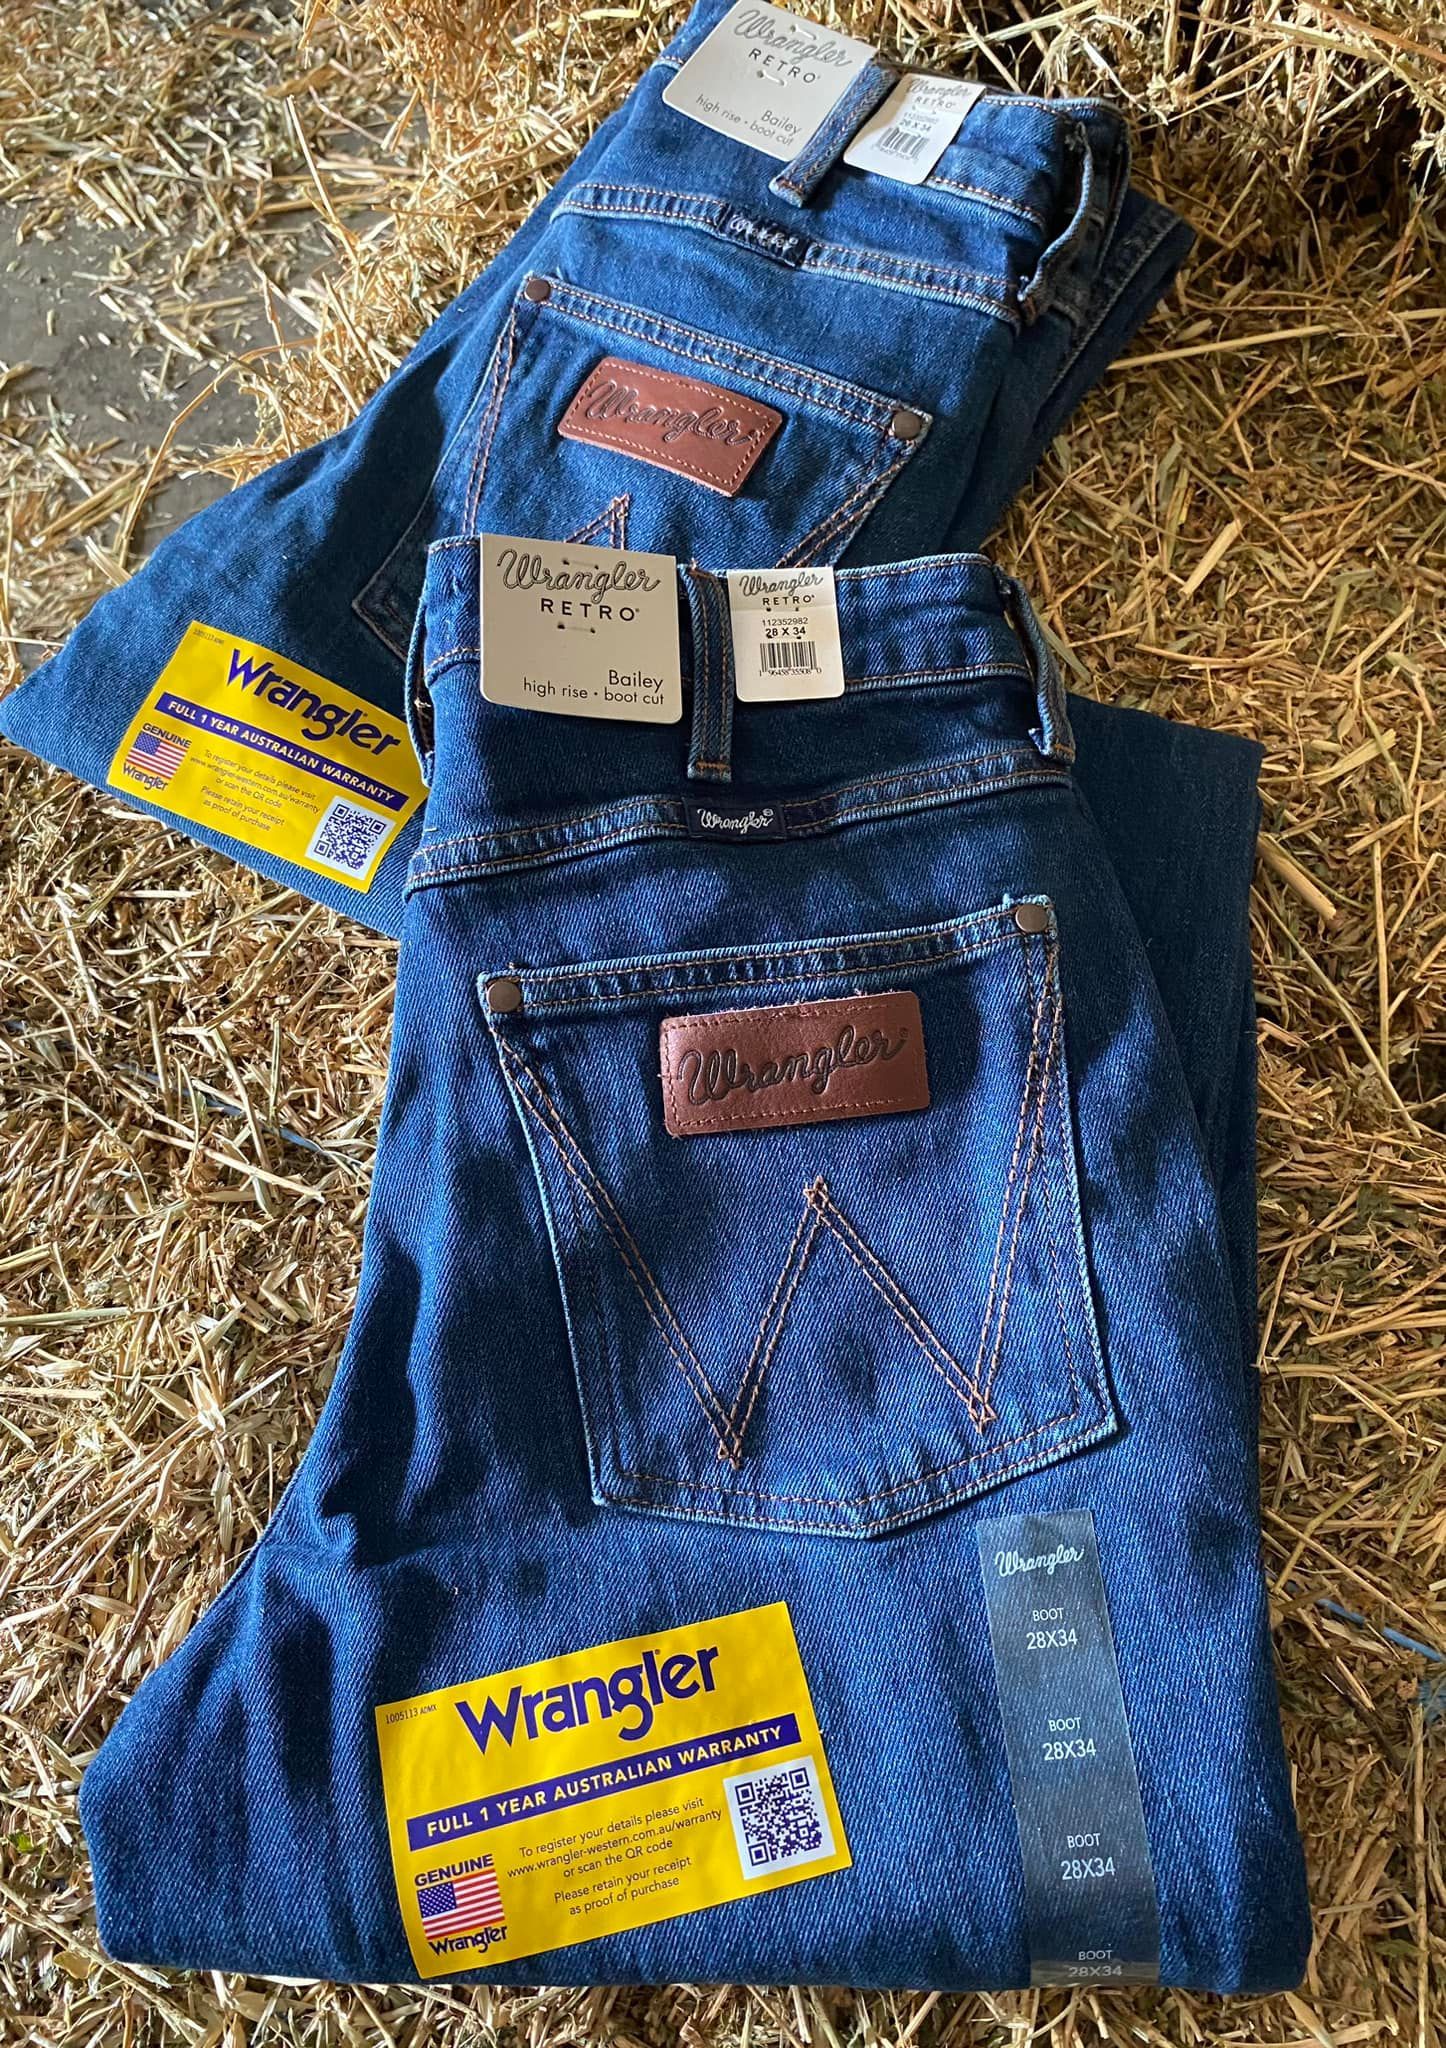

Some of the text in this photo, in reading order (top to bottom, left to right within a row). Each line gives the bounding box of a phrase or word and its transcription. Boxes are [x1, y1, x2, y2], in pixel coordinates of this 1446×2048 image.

[735, 9, 852, 68] Wrangler
[748, 48, 819, 84] RETRO
[915, 97, 954, 109] RETRO
[696, 93, 795, 145] high rise boot cut
[761, 110, 802, 136] Bailey
[586, 379, 755, 446] Wrangler
[497, 549, 660, 604] Wrangler
[739, 572, 823, 596] Wrangler
[541, 598, 636, 622] RETRO
[762, 595, 812, 606] RETRO
[762, 617, 808, 627] 112352982
[766, 626, 806, 637] 28 X 34
[524, 678, 664, 705] high rise boot cut
[609, 669, 664, 690] Bailey
[226, 648, 401, 755] Wrangler
[142, 722, 192, 747] GENUINE
[168, 701, 395, 802] FULL 1 YEAR AUSTRALIAN WARRANTY
[123, 762, 168, 790] Wrangler
[254, 770, 276, 783] details
[276, 780, 300, 794] please
[301, 790, 317, 800] visit
[201, 785, 285, 826] Please retain your receipt
[224, 781, 240, 791] scan
[240, 786, 252, 796] the
[252, 791, 265, 802] QR
[265, 796, 282, 808] code
[212, 803, 232, 815] proof
[231, 809, 240, 818] of
[240, 814, 271, 831] purchase
[697, 809, 773, 834] Wrangler
[678, 1024, 907, 1105] Wrangler
[995, 1544, 1085, 1577] Wrangler
[1033, 1607, 1064, 1622] BOOT
[1026, 1631, 1078, 1651] 28X34
[455, 1645, 719, 1755] Wrangler
[386, 1707, 418, 1724] 1005113
[1049, 1717, 1081, 1733] BOOT
[1043, 1738, 1097, 1761] 28X34
[427, 1725, 782, 1837] FULL 1 YEAR AUSTRALIAN WARRANTY
[519, 1797, 705, 1858] To register your details please visit
[1067, 1833, 1100, 1849] BOOT
[507, 1809, 722, 1878] www.wrangler-western.com.au/warranty
[414, 1853, 495, 1888] GENUINE
[563, 1838, 673, 1878] or scan the QR code
[1061, 1856, 1116, 1881] 28X34
[554, 1856, 692, 1904] Please retain your receipt
[569, 1877, 680, 1916] as proof of purchase
[428, 1924, 509, 1957] Wrangler
[1079, 1950, 1113, 1960] BOOT
[1067, 1965, 1122, 1977] 28X34
